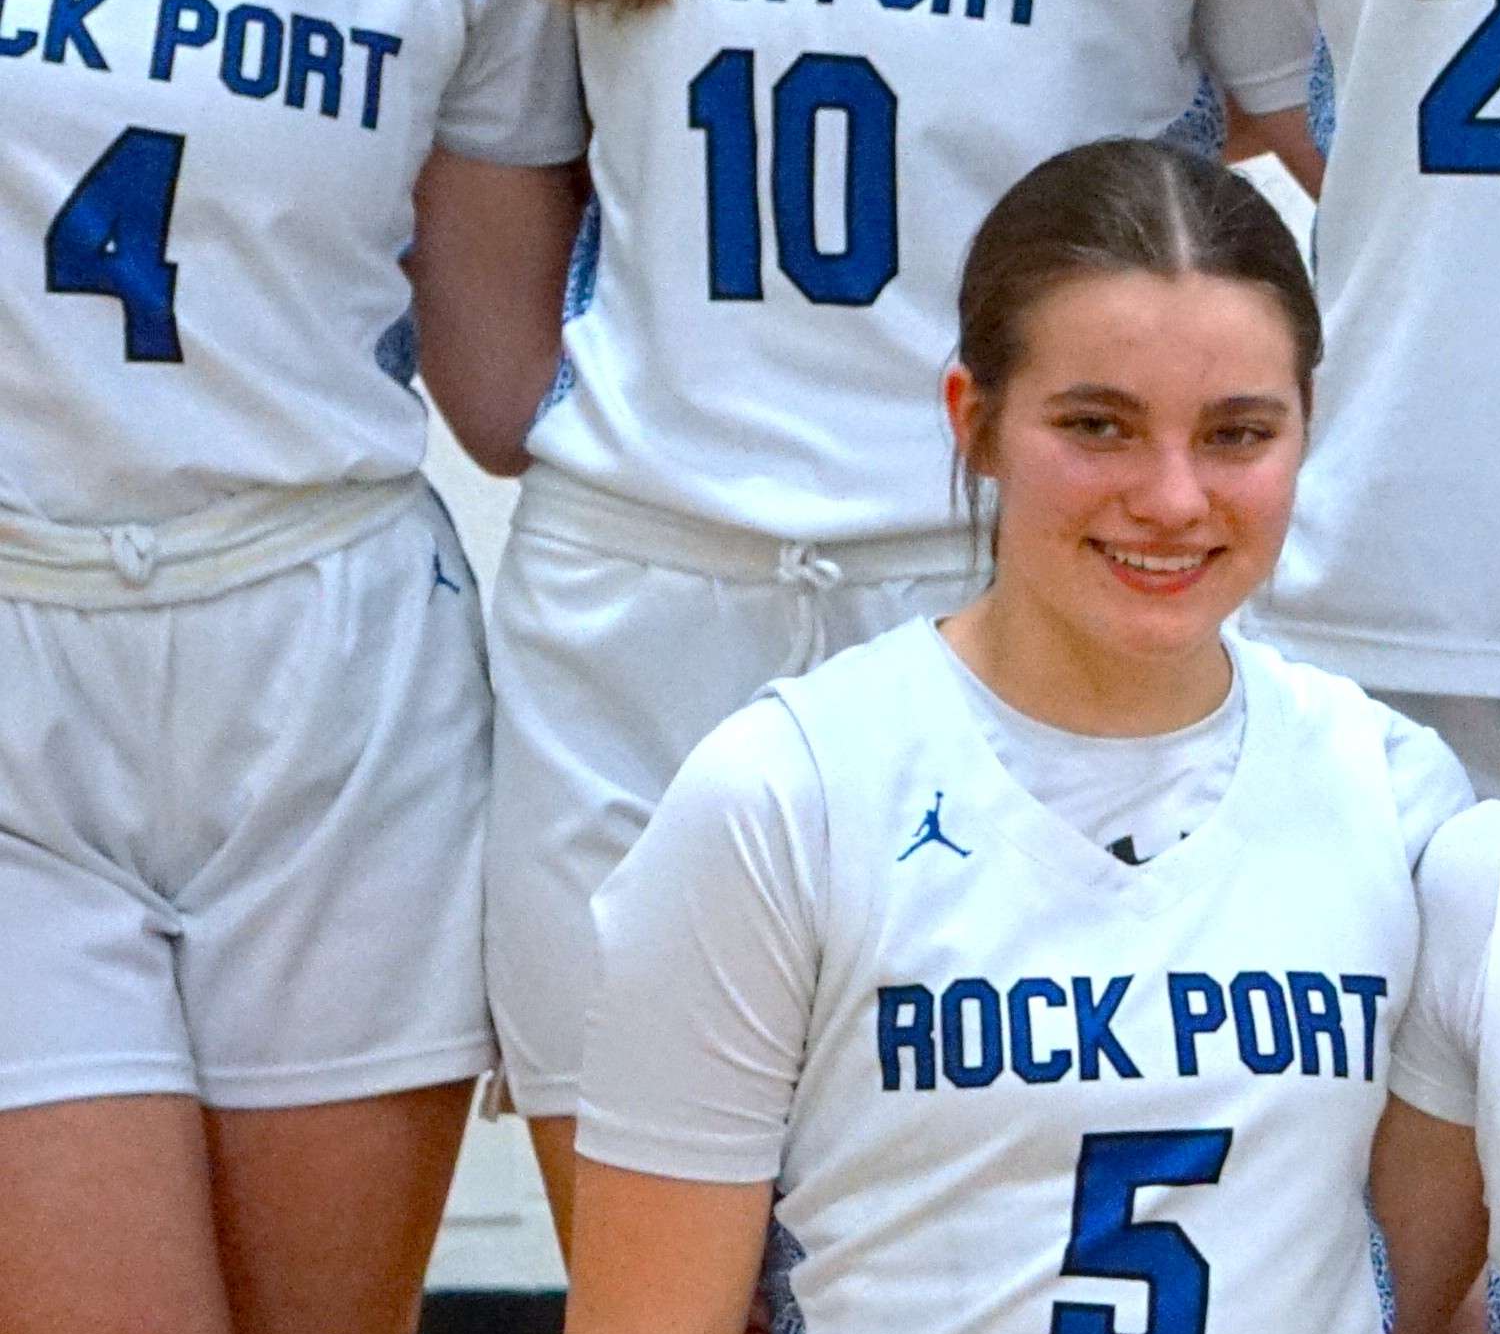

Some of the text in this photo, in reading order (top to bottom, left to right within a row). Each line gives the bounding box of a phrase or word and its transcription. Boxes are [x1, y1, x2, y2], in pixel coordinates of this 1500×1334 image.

[44, 125, 186, 364] 4
[688, 48, 899, 307] 10
[877, 971, 1388, 1092] ROCK PORT
